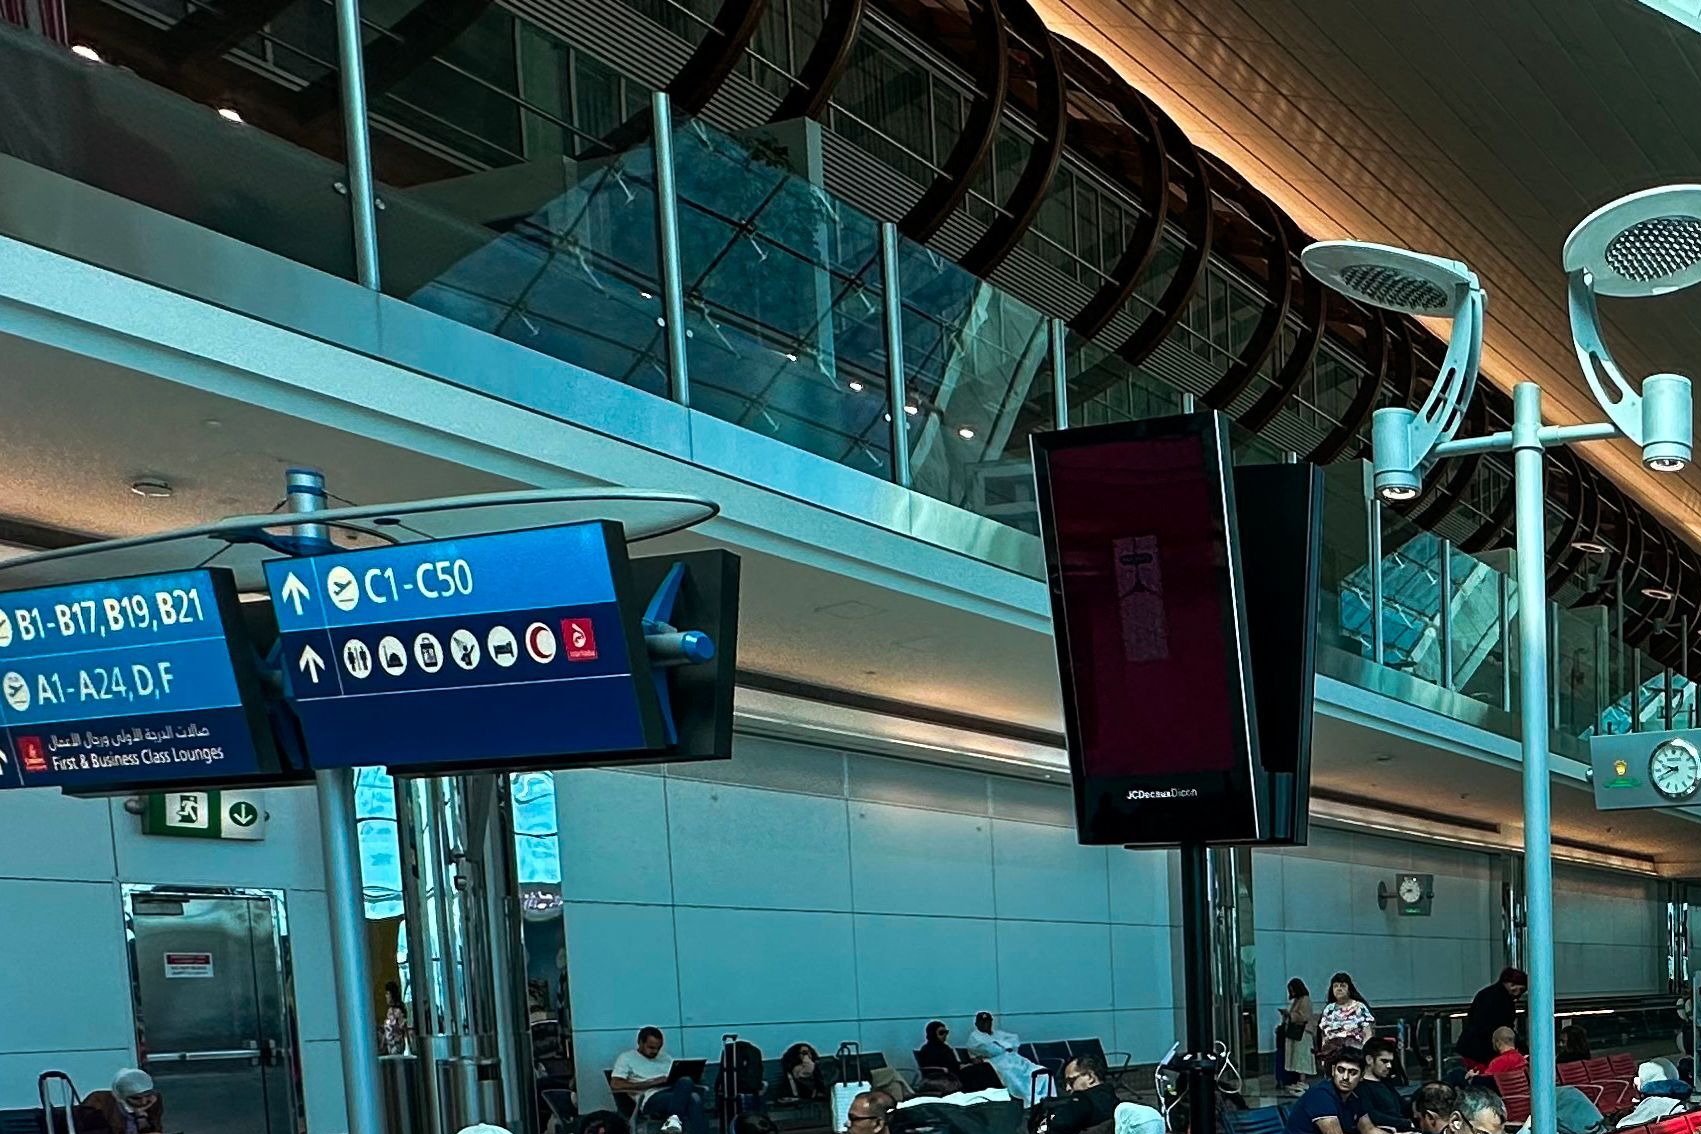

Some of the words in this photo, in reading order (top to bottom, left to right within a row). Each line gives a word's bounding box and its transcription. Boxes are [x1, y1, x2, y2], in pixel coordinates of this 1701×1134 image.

[52, 756, 79, 771] First
[79, 753, 90, 769] &
[91, 751, 140, 768] Business
[141, 748, 171, 764] Class
[171, 747, 224, 764] Lounges
